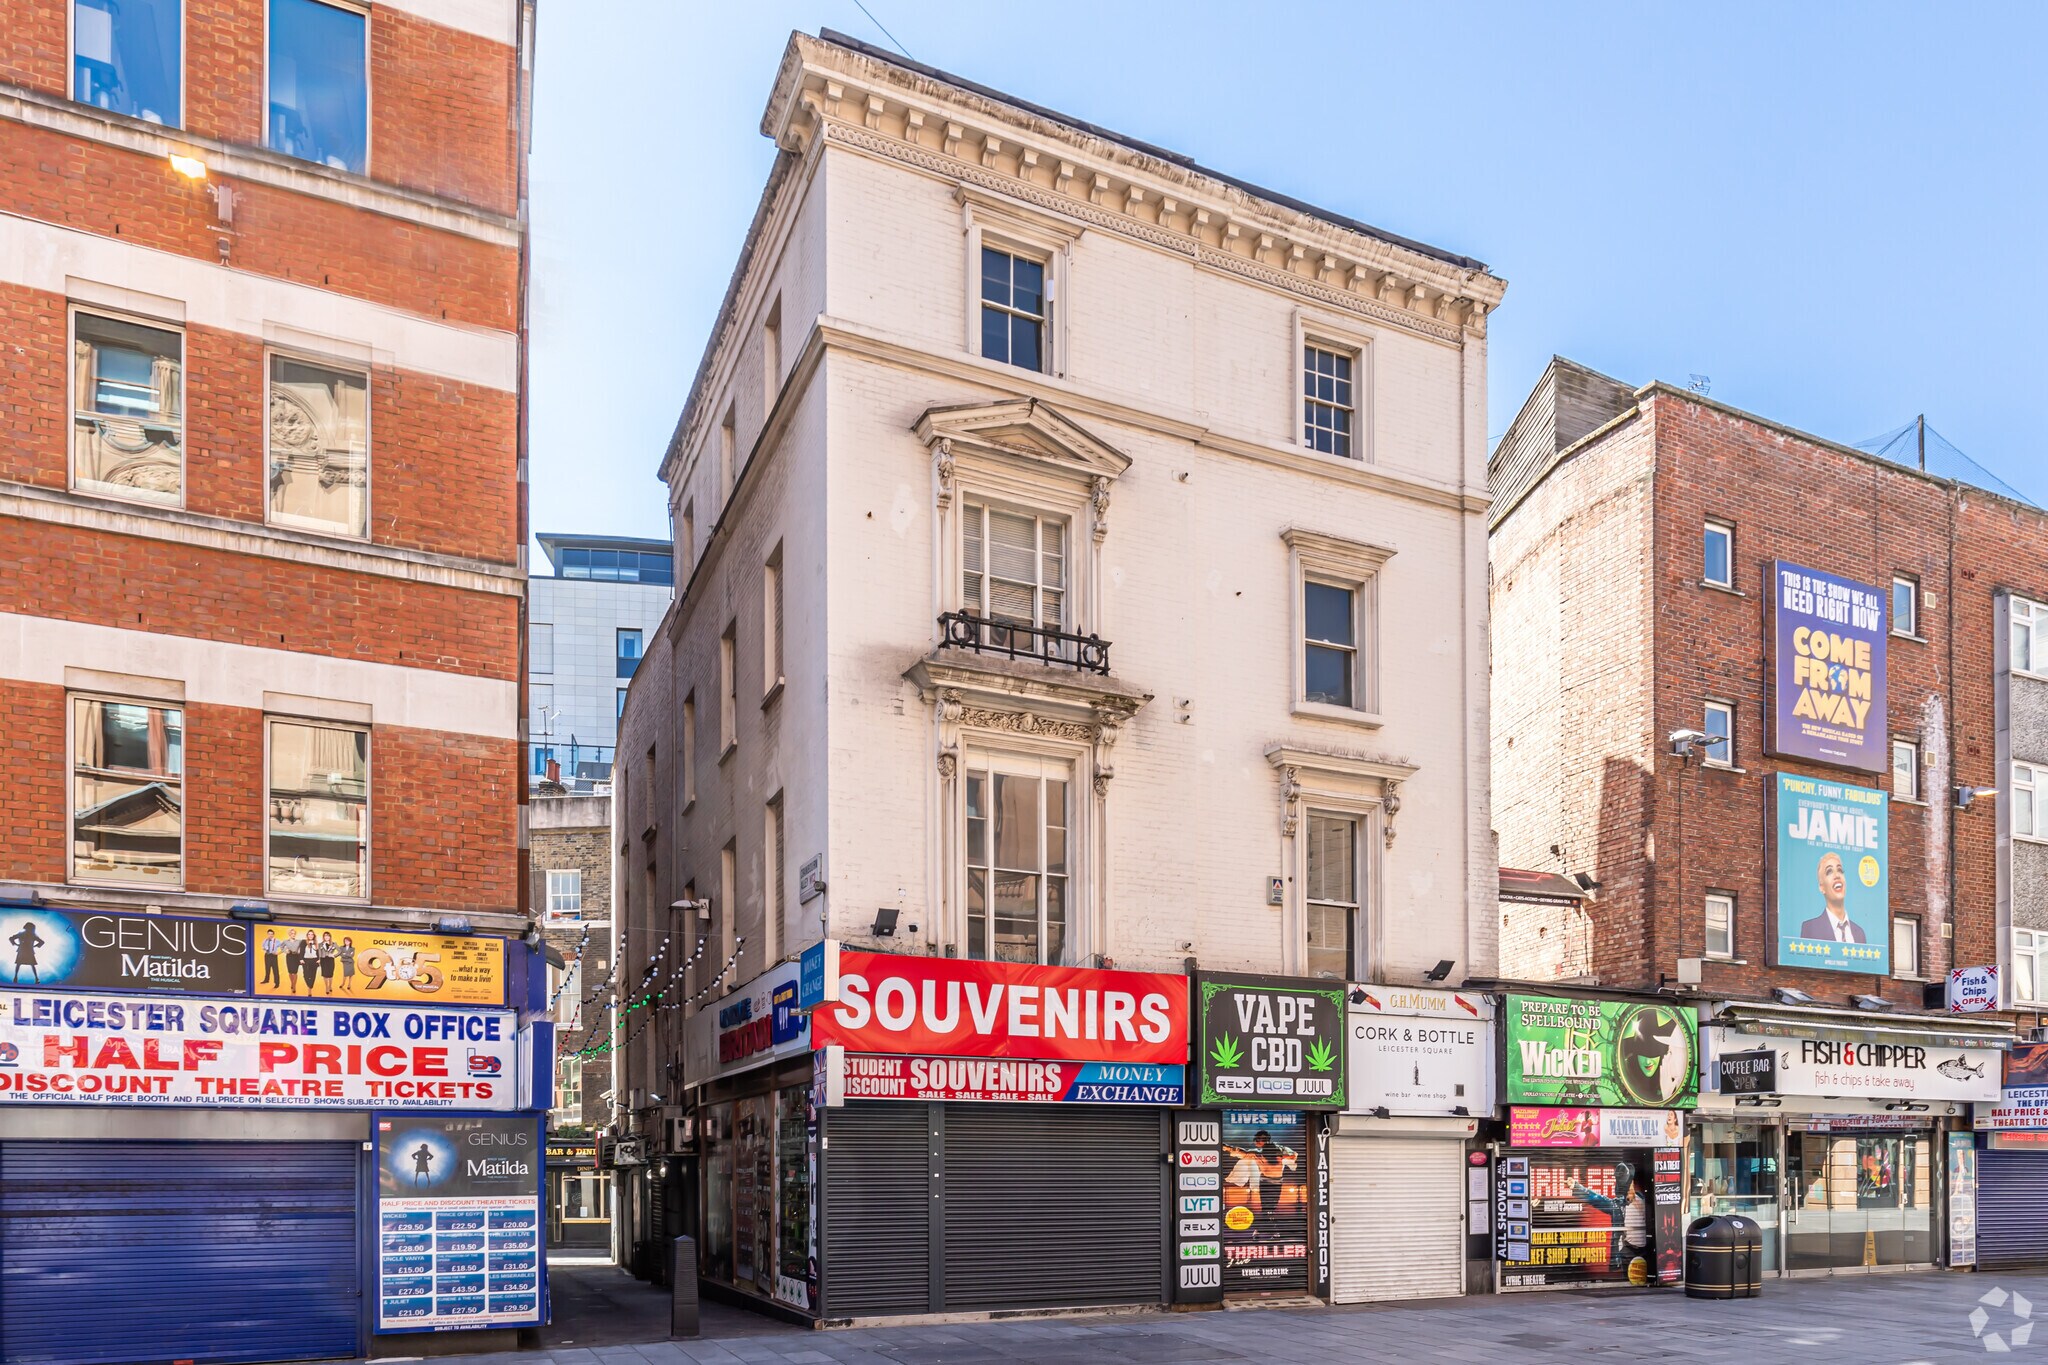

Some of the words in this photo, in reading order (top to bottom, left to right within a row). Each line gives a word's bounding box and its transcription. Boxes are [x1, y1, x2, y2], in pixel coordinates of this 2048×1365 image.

[1803, 577, 1810, 592] IS
[1812, 579, 1826, 596] THE
[1828, 582, 1851, 603] SHOW
[1851, 590, 1864, 606] WE
[1865, 594, 1879, 610] ALL
[1784, 587, 1814, 615] NEED
[1816, 595, 1850, 625] RIGHT
[1852, 603, 1881, 632] NOW'
[1793, 626, 1871, 671] COME
[1794, 655, 1871, 700] FROM
[1792, 687, 1871, 730] AWAY
[1788, 806, 1878, 850] JAMIE
[82, 915, 247, 956] GENIUS
[121, 954, 210, 980] Matilda
[357, 947, 394, 990] 9
[408, 951, 444, 994] 5
[1962, 976, 1980, 986] Fish
[1980, 976, 1988, 984] &
[1962, 986, 1987, 996] Chips
[834, 974, 1172, 1044] SOUVENIRS
[1234, 993, 1316, 1036] VAPE
[1520, 1000, 1568, 1016] PREPARE
[1570, 1004, 1584, 1016] TO
[1588, 1006, 1600, 1017] BE
[14, 998, 184, 1032] LEICESTER
[200, 1006, 318, 1036] SQUARE
[334, 1011, 390, 1038] BOX
[404, 1014, 500, 1042] OFFICE
[1521, 1014, 1600, 1030] SPELLBOUND
[1355, 1026, 1398, 1042] CORK
[1403, 1028, 1412, 1042] &
[1418, 1029, 1475, 1045] BOTTLE
[1765, 1026, 1782, 1037] chips
[44, 1034, 223, 1071] HALF
[260, 1042, 448, 1077] PRICE
[1251, 1036, 1302, 1072] CBD
[1378, 1045, 1419, 1054] LEICESTER
[1422, 1047, 1452, 1055] SQUARE
[1802, 1040, 1841, 1065] FISH
[1844, 1042, 1854, 1066] &
[1856, 1043, 1926, 1070] CHIPPER
[844, 1058, 902, 1077] STUDENT
[1098, 1066, 1168, 1082] MONEY
[1721, 1060, 1750, 1075] COFFEE
[1752, 1058, 1770, 1072] BAR
[910, 1058, 1062, 1094] SOUVENIRS
[1815, 1071, 1830, 1088] fish
[1833, 1072, 1838, 1085] &
[1840, 1072, 1862, 1090] chips
[1864, 1074, 1870, 1086] &
[1872, 1074, 1890, 1088] take
[1893, 1077, 1915, 1091] away
[0, 1073, 174, 1094] DISCOUNT
[195, 1077, 344, 1098] THEATRE
[366, 1080, 493, 1099] TICKETS
[1076, 1085, 1180, 1102] EXCHANGE
[1218, 1080, 1252, 1090] RELX
[1258, 1080, 1292, 1091] IQOS
[1302, 1080, 1326, 1094] JUUL
[10, 1092, 28, 1100] THE
[33, 1093, 76, 1101] OFFICIAL
[106, 1094, 134, 1102] PRICE
[196, 1096, 218, 1104] FULL
[218, 1096, 244, 1104] PRICE
[248, 1096, 261, 1104] ON
[347, 1098, 384, 1106] SUBJECT
[402, 1099, 453, 1107] AVAILABILITY
[918, 1090, 950, 1099] SALE
[956, 1092, 983, 1100] SALE
[992, 1092, 1019, 1100] SALE
[1027, 1093, 1054, 1101] SALE
[1433, 1092, 1447, 1100] shop
[2017, 1100, 2032, 1108] THE
[1230, 1113, 1268, 1124] LIVES
[1991, 1108, 2012, 1117] HALF
[2014, 1108, 2041, 1116] PRICE
[1610, 1119, 1640, 1136] MAMMA
[1642, 1119, 1659, 1136] MIA!
[1993, 1119, 2030, 1127] THEATRE
[468, 1133, 528, 1146] GENIUS
[1183, 1124, 1216, 1142] JUUL
[546, 1148, 564, 1156] BAR
[567, 1148, 574, 1156] &
[1194, 1154, 1218, 1166] vype
[467, 1159, 529, 1177] Matilda
[1316, 1134, 1328, 1206] VAPE
[1182, 1176, 1216, 1187] IQOS
[1184, 1198, 1214, 1212] LYFT
[1655, 1192, 1681, 1201] WITNESS
[1498, 1181, 1507, 1230] SHOWS
[1184, 1223, 1216, 1231] RELX
[1192, 1244, 1208, 1256] CBD
[1224, 1244, 1306, 1259] THRILLER
[1318, 1211, 1328, 1284] SHOP
[1498, 1234, 1507, 1258] ALL
[1546, 1248, 1568, 1264] SHOP
[1570, 1246, 1607, 1264] OPPOSITE
[398, 1266, 424, 1274] £15.00
[1184, 1267, 1217, 1286] JUUL
[1506, 1276, 1522, 1286] LYRIC
[1522, 1274, 1546, 1286] THEATRE
[504, 1304, 528, 1312] £29.50
